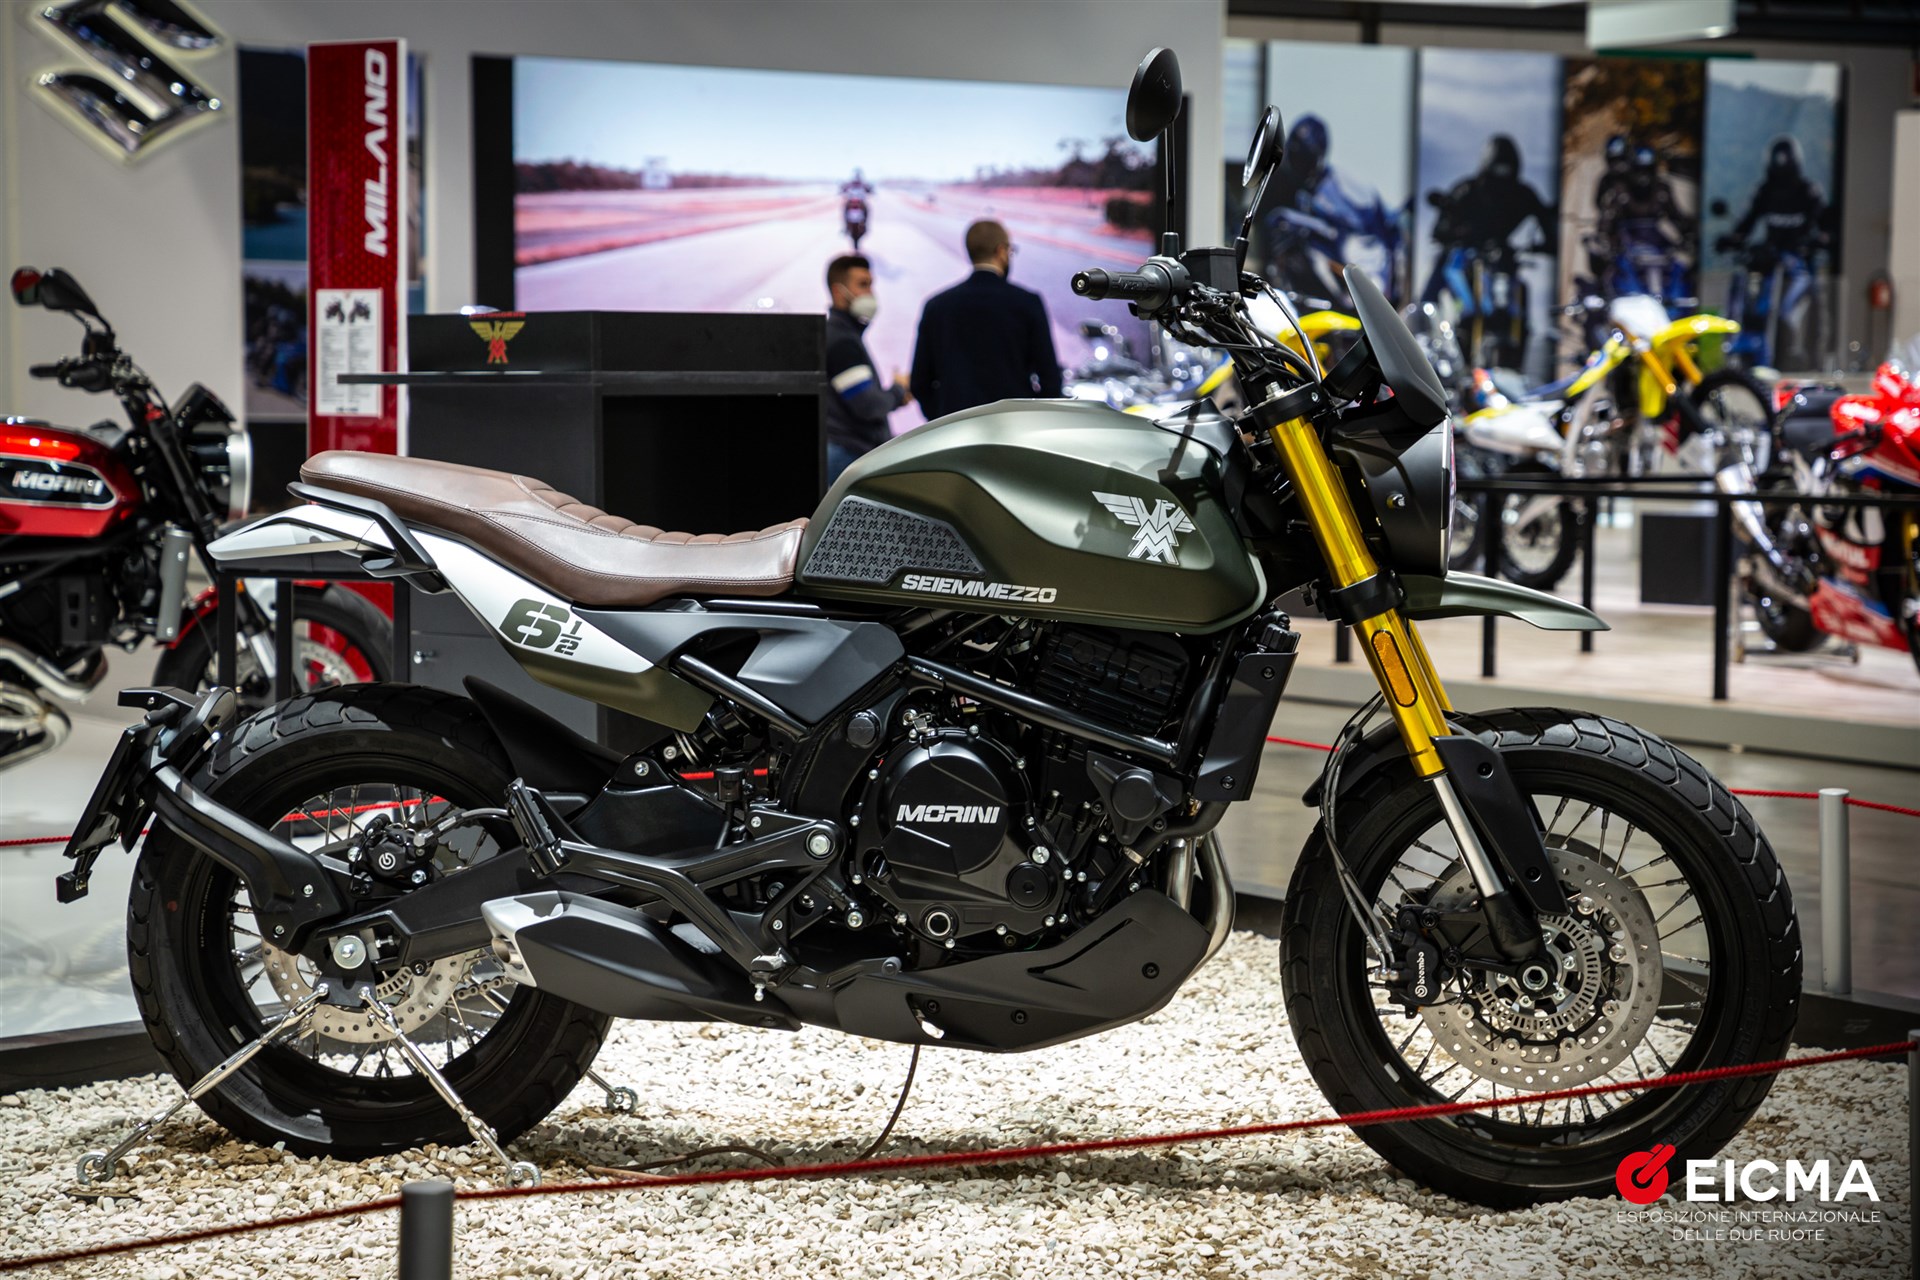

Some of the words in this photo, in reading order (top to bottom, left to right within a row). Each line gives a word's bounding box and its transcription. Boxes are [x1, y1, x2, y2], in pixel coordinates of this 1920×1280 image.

[365, 48, 387, 257] MILANO
[12, 471, 103, 496] MORINI
[901, 574, 1058, 603] SEIEMMEZZO
[896, 804, 1000, 824] MORINI
[1416, 951, 1426, 985] brembo
